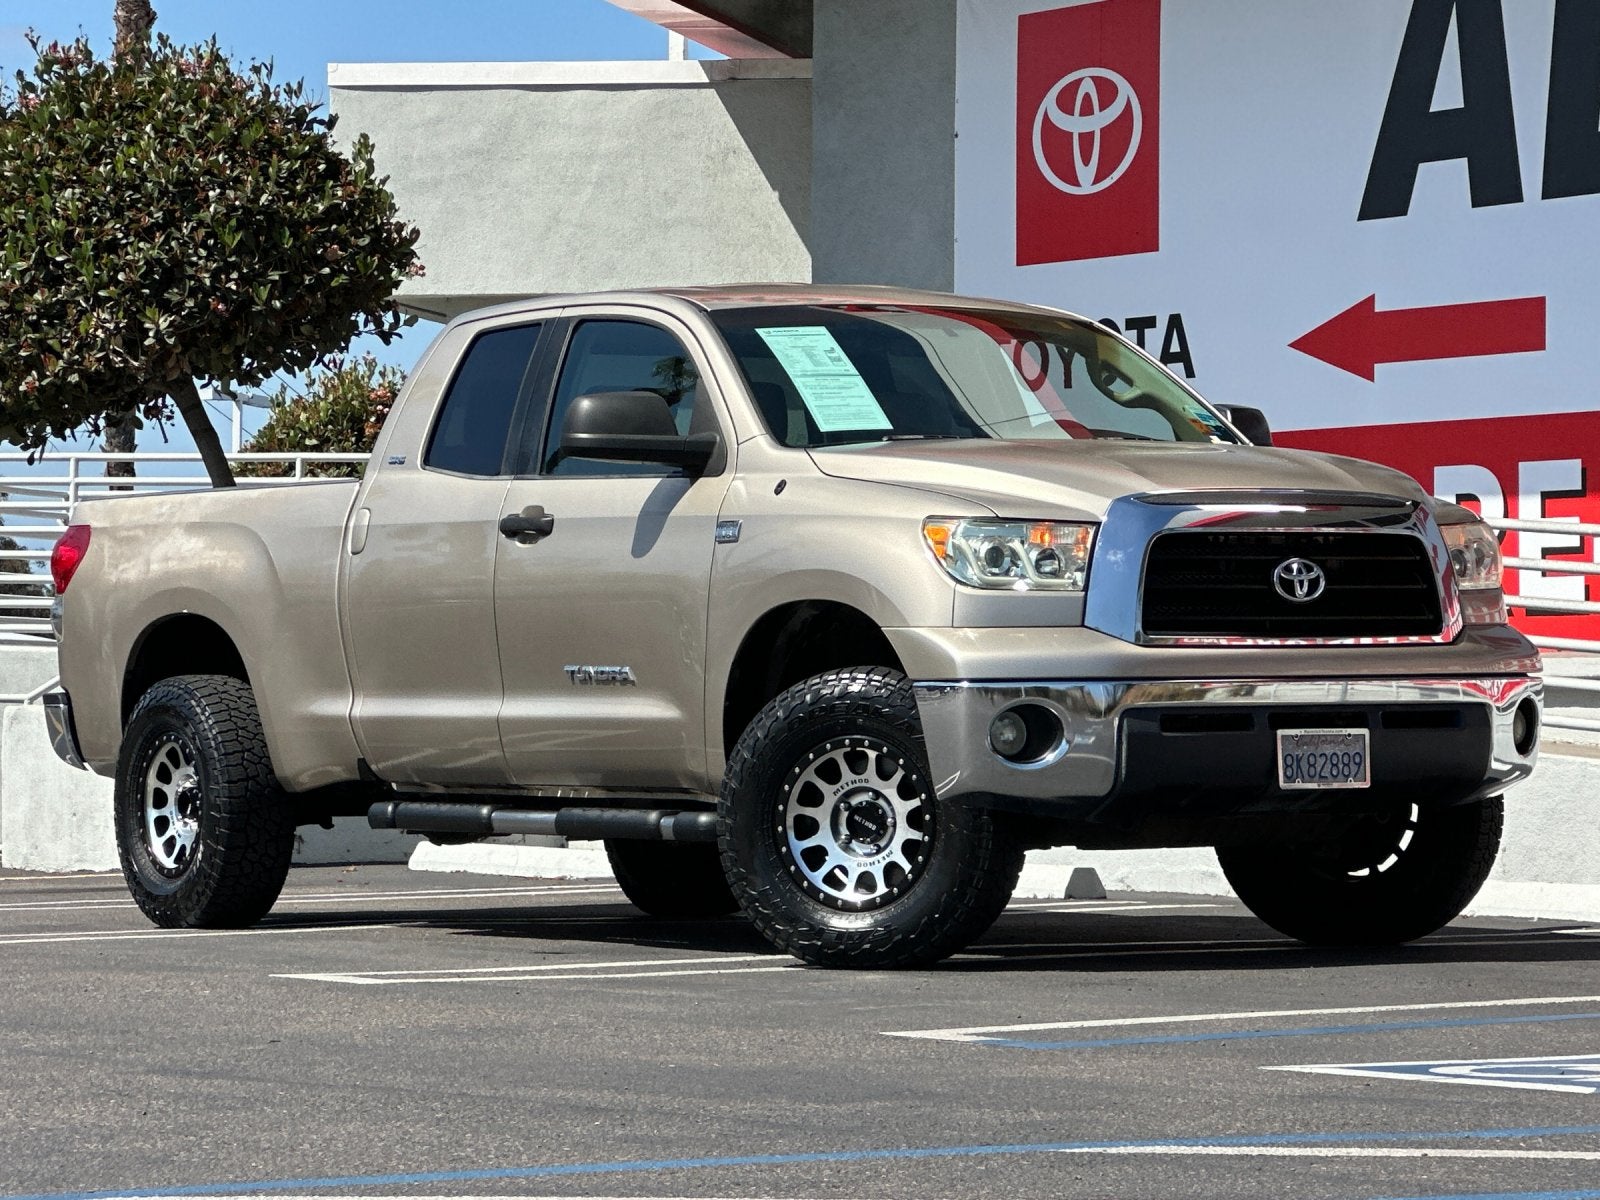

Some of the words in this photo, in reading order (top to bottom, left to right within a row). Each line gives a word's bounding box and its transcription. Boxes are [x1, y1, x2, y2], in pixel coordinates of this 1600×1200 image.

[1011, 313, 1196, 392] OYTA
[1283, 751, 1363, 781] 8K82889
[832, 778, 870, 797] METHOD
[853, 814, 878, 832] METHOD
[856, 849, 894, 868] METHOD
